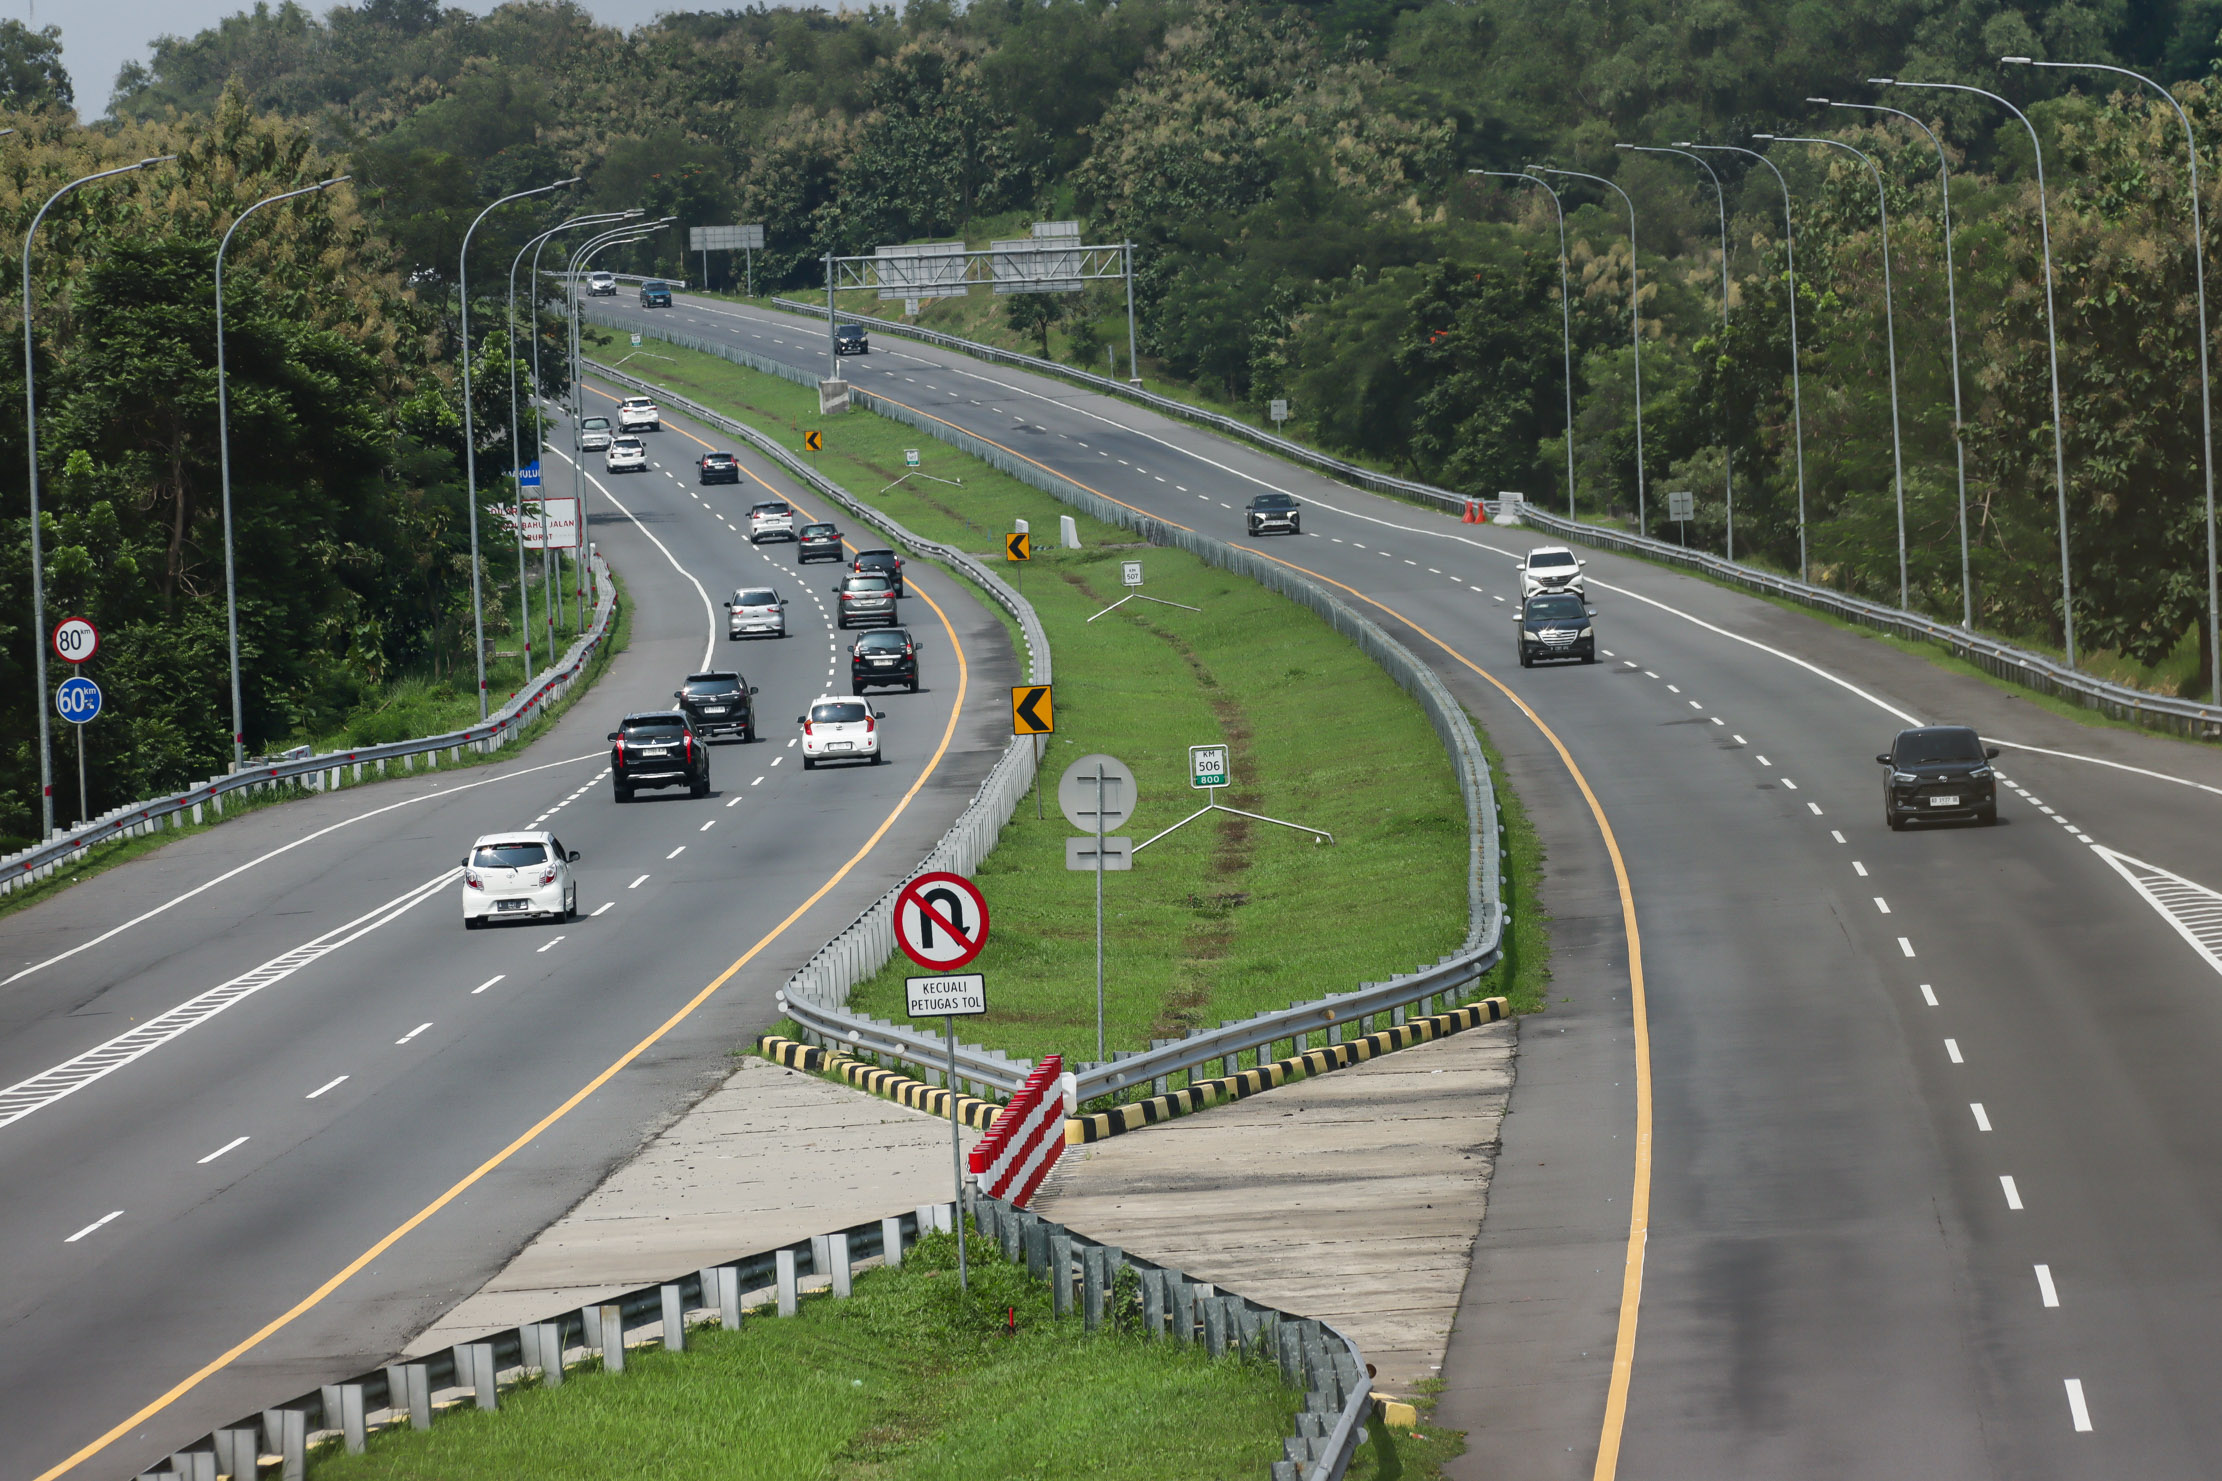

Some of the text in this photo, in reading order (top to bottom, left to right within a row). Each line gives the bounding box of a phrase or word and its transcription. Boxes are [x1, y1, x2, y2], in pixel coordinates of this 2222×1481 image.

[549, 519, 575, 528] JALAN
[59, 630, 81, 651] 80
[59, 687, 85, 713] 60
[1199, 761, 1220, 772] 506
[1201, 776, 1219, 784] 800
[923, 981, 967, 995] KECUALI
[911, 997, 982, 1011] PETUGAS TOL
